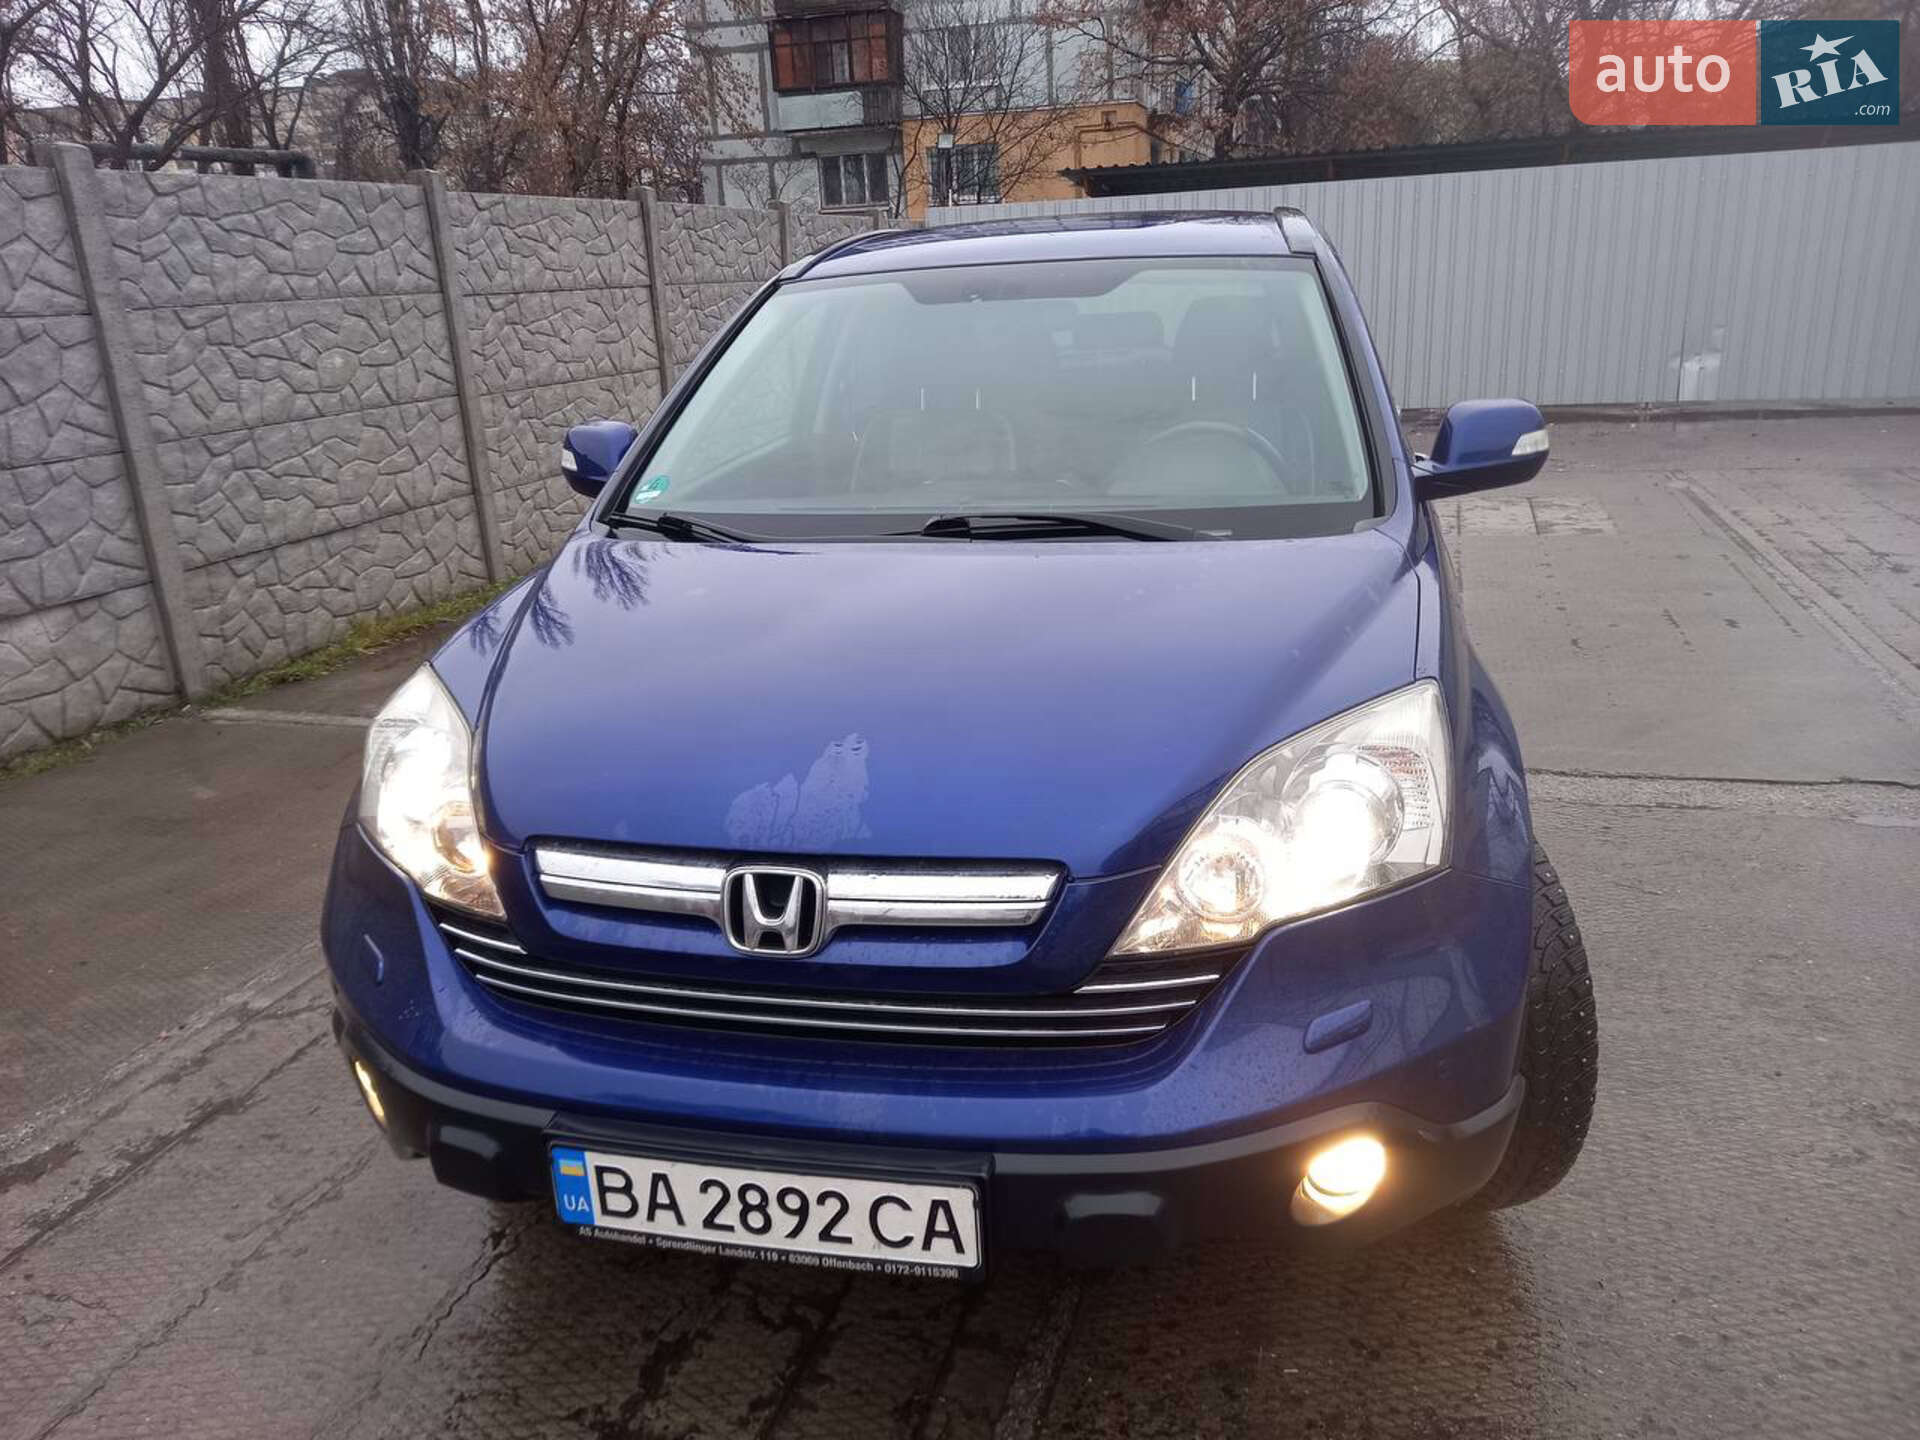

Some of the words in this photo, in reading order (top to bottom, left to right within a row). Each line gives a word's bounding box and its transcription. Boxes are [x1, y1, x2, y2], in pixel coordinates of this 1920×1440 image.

[564, 1193, 589, 1213] UA
[594, 1165, 686, 1226] BA
[699, 1179, 853, 1245] 2892
[869, 1195, 966, 1255] CA
[821, 1257, 874, 1272] Offenbach
